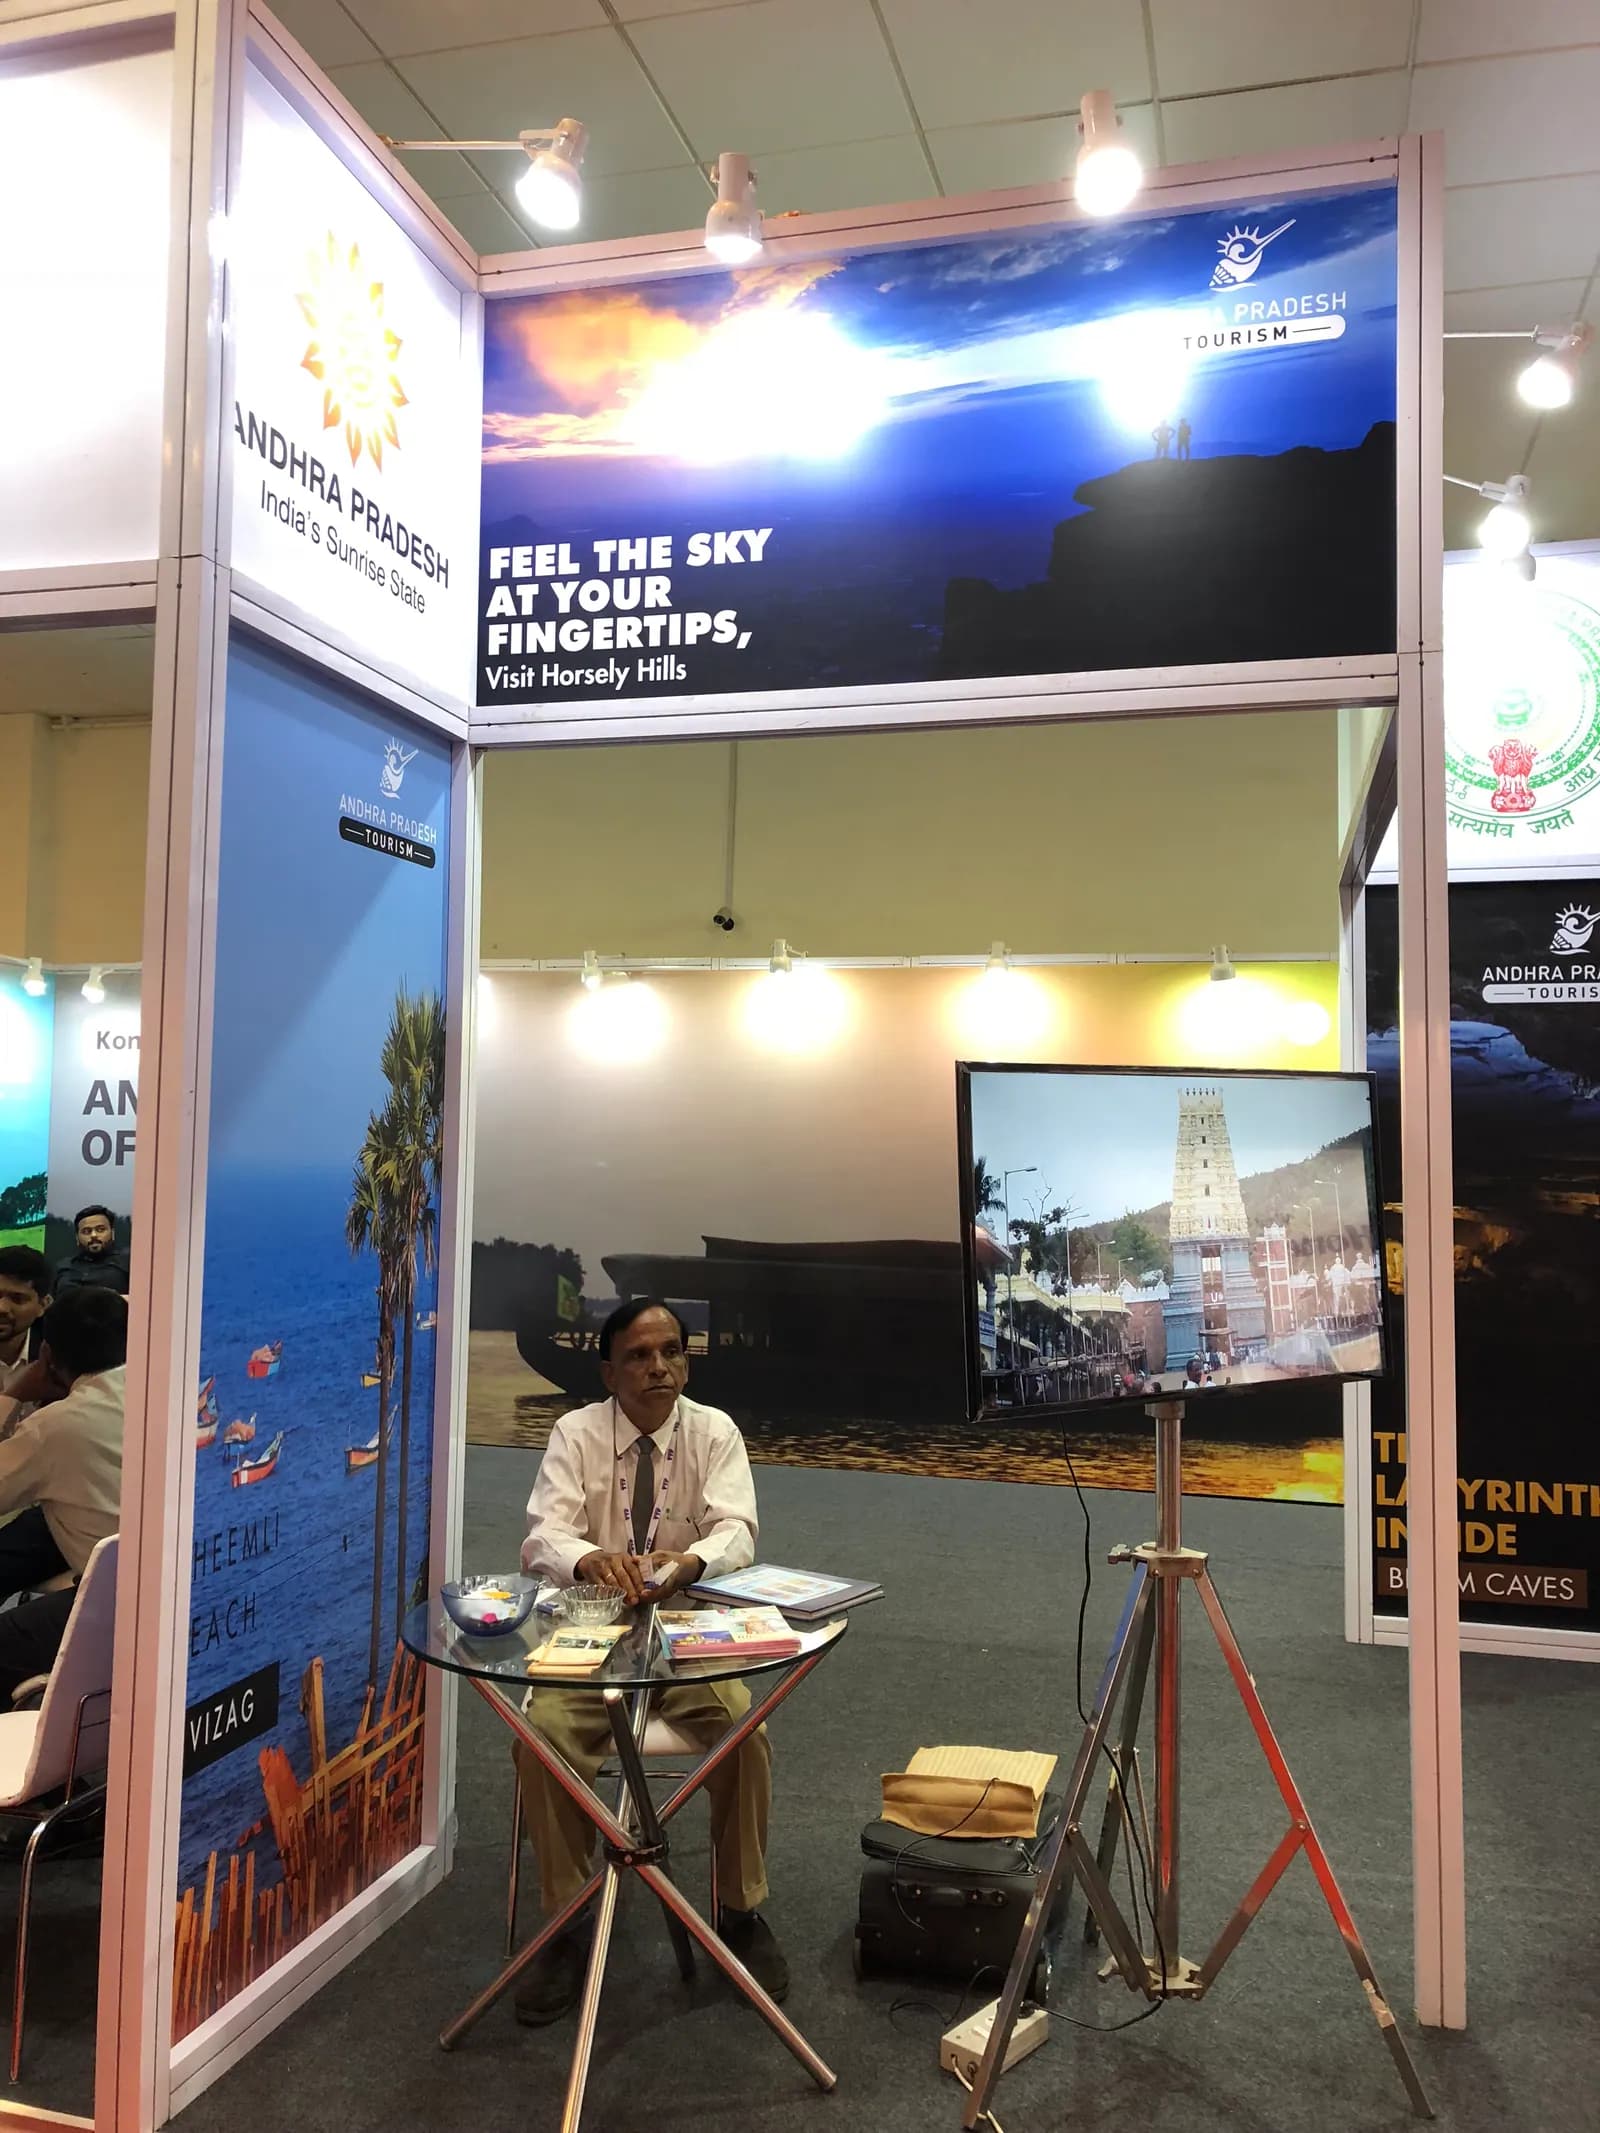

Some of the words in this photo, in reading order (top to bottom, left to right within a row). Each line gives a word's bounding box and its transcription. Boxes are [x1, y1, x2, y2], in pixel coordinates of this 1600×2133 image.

[1234, 291, 1347, 322] PRADESH
[1183, 325, 1287, 350] TOURISM
[261, 480, 321, 544] India's
[326, 525, 386, 587] Sunrise
[390, 569, 425, 614] State
[351, 487, 449, 589] PRADESH
[489, 543, 580, 579] FEEL
[593, 536, 672, 572] THE
[686, 528, 773, 567] SKY
[485, 583, 539, 617] AT
[550, 575, 672, 614] YOUR
[488, 609, 752, 656] FINGERTIPS,
[485, 664, 535, 690] Visit
[542, 658, 630, 690] Horsely
[637, 654, 687, 682] Hills
[339, 793, 387, 827] ANDHRA
[390, 812, 437, 845] PRADESH
[1448, 810, 1515, 838] सत्यमेव
[1527, 809, 1575, 834] जयते
[365, 828, 413, 858] TOURISM
[1482, 965, 1564, 982] ANDHRA
[1485, 1573, 1574, 1601] CAVES
[191, 1592, 256, 1657] EACH
[190, 1689, 255, 1752] VIZAG
